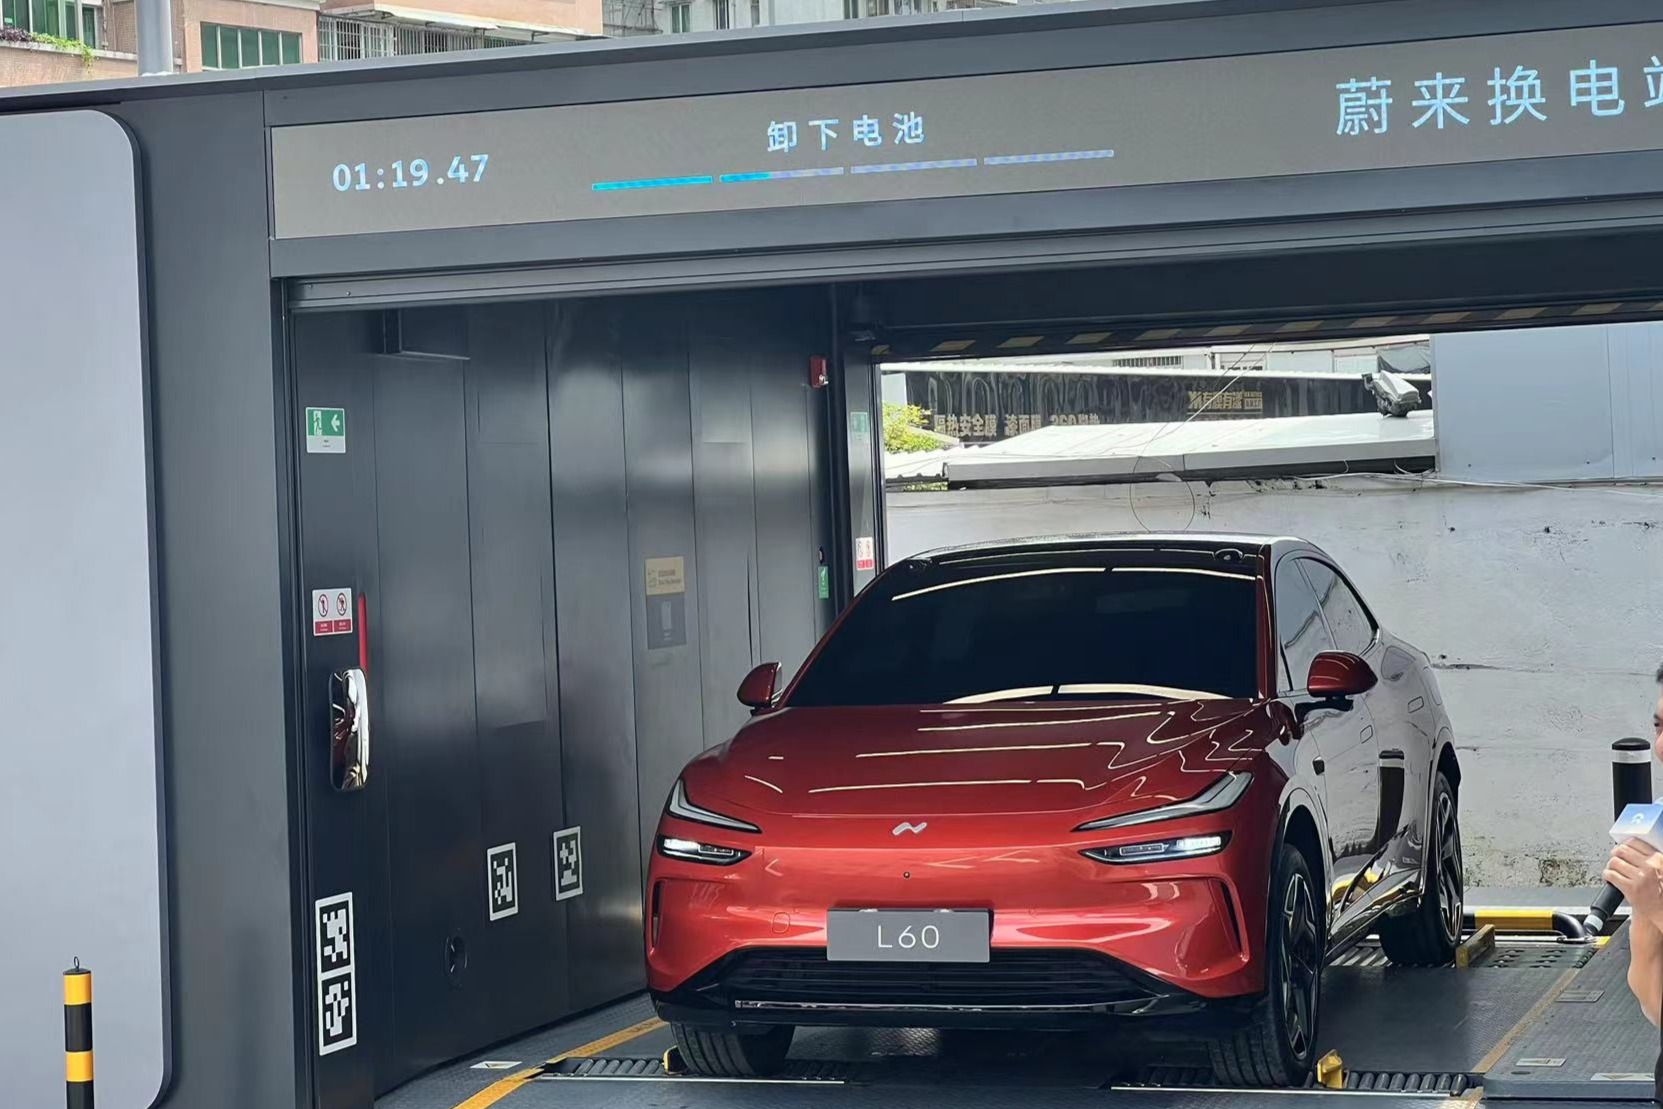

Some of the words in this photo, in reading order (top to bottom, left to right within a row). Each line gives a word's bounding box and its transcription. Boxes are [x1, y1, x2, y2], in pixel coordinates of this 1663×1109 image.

[767, 111, 925, 152] 卸下电池
[332, 153, 489, 192] 01:19.47
[933, 414, 997, 438] 隔热安全膜
[877, 925, 940, 949] L60
